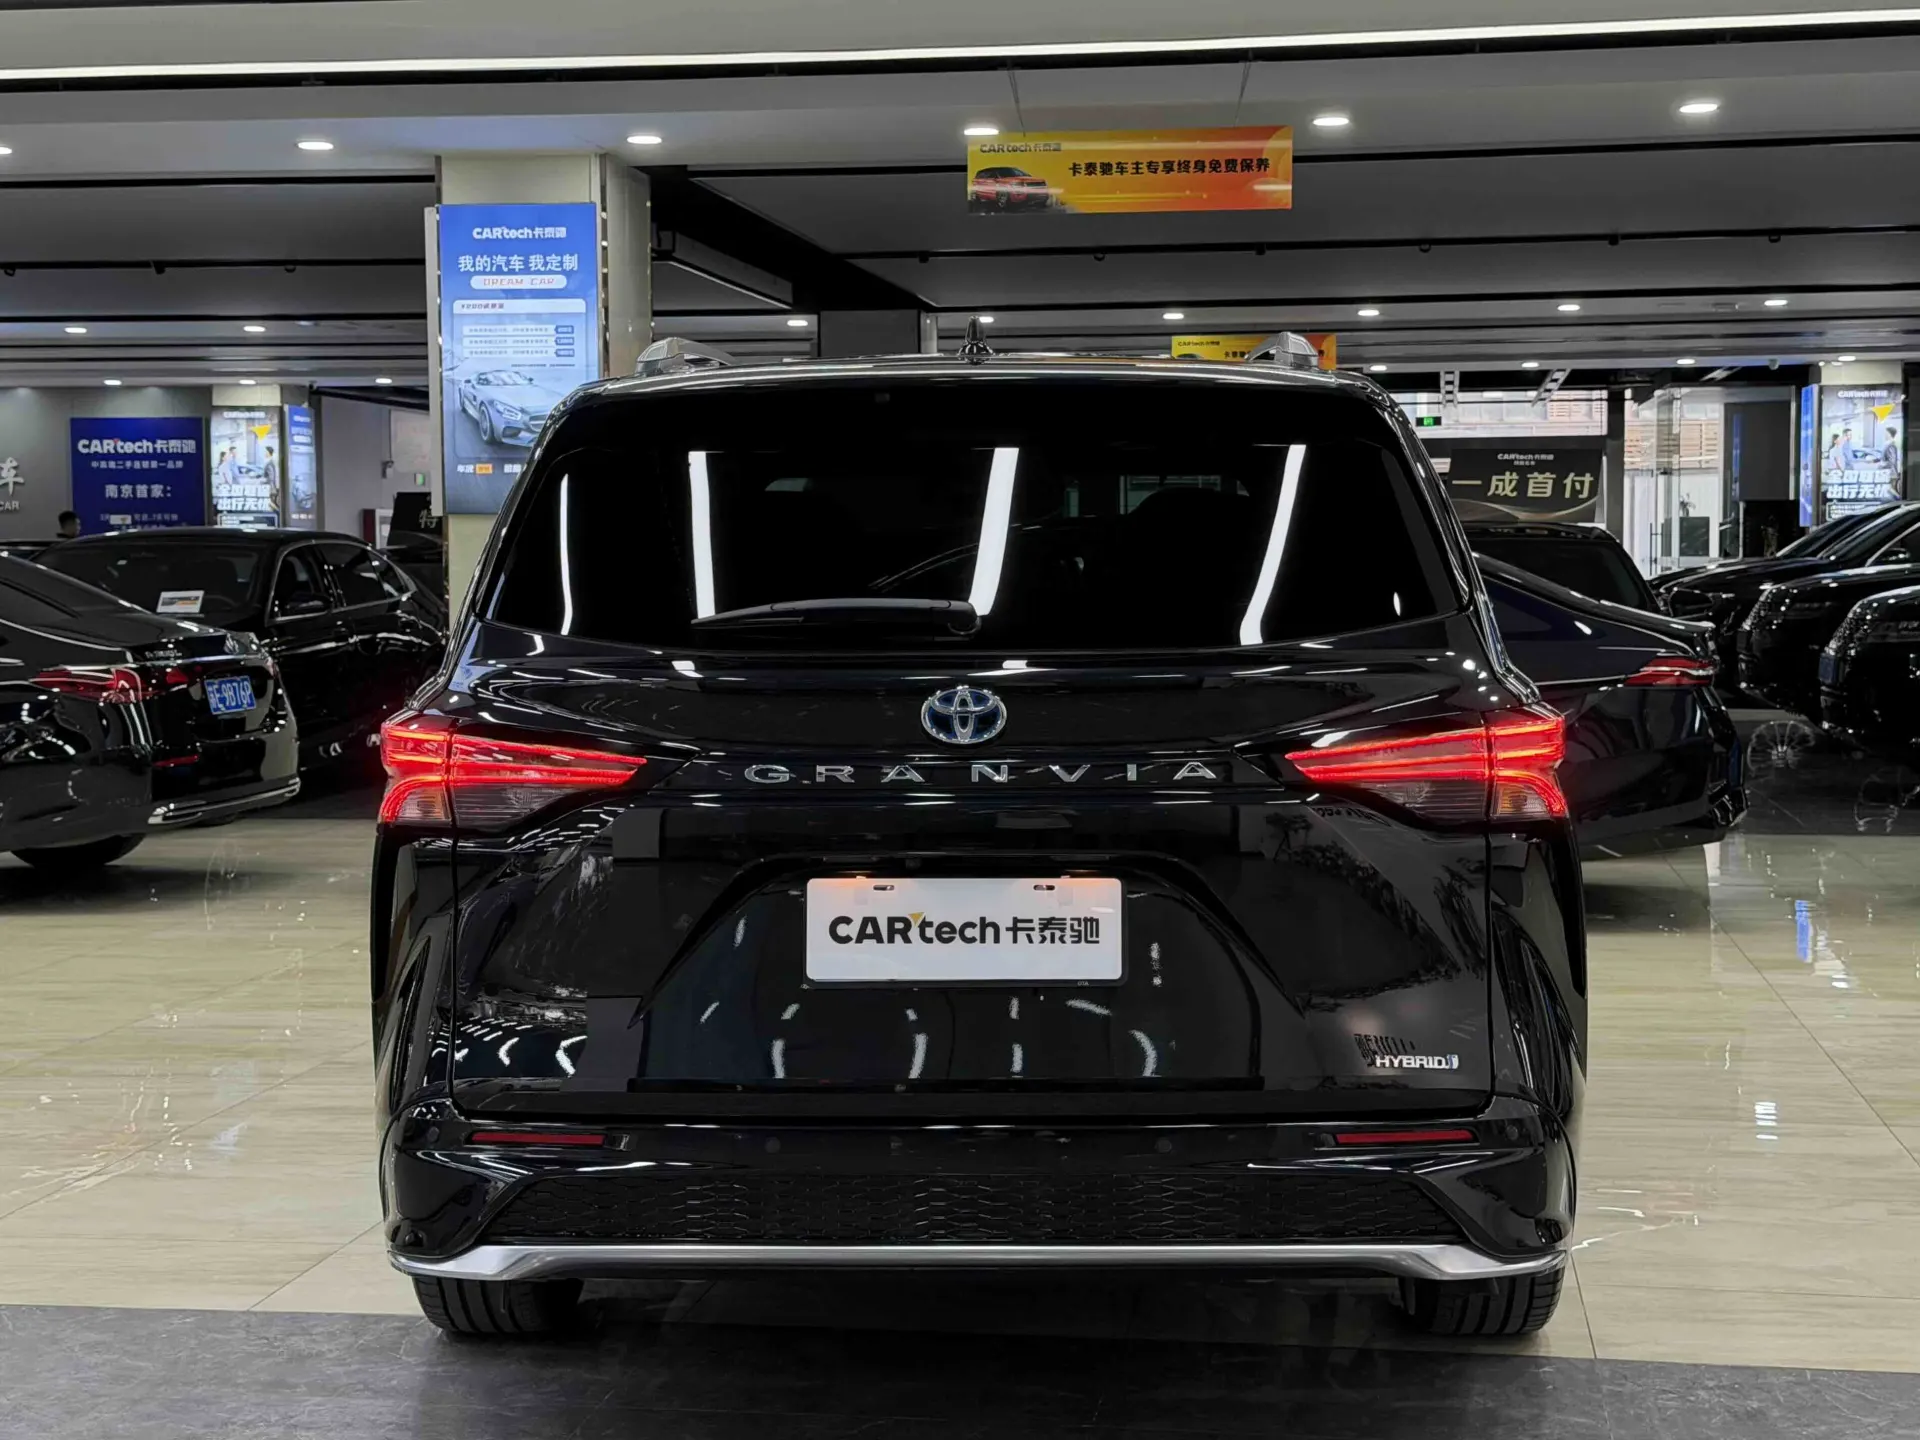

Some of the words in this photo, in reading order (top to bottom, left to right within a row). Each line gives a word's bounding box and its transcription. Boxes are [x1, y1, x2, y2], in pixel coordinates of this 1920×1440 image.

[1068, 157, 1271, 177] 卡泰驰车主专享终身免费保养
[458, 254, 524, 272] 我的汽车
[528, 253, 578, 271] 我定制
[530, 277, 555, 285] CAR
[77, 439, 153, 454] CARtech
[1452, 471, 1594, 499] 一成首付
[745, 763, 1219, 784] GRANVIA
[828, 912, 1000, 944] CARtech
[1006, 916, 1100, 944] 卡泰驰
[1375, 1054, 1446, 1069] HYBRID
